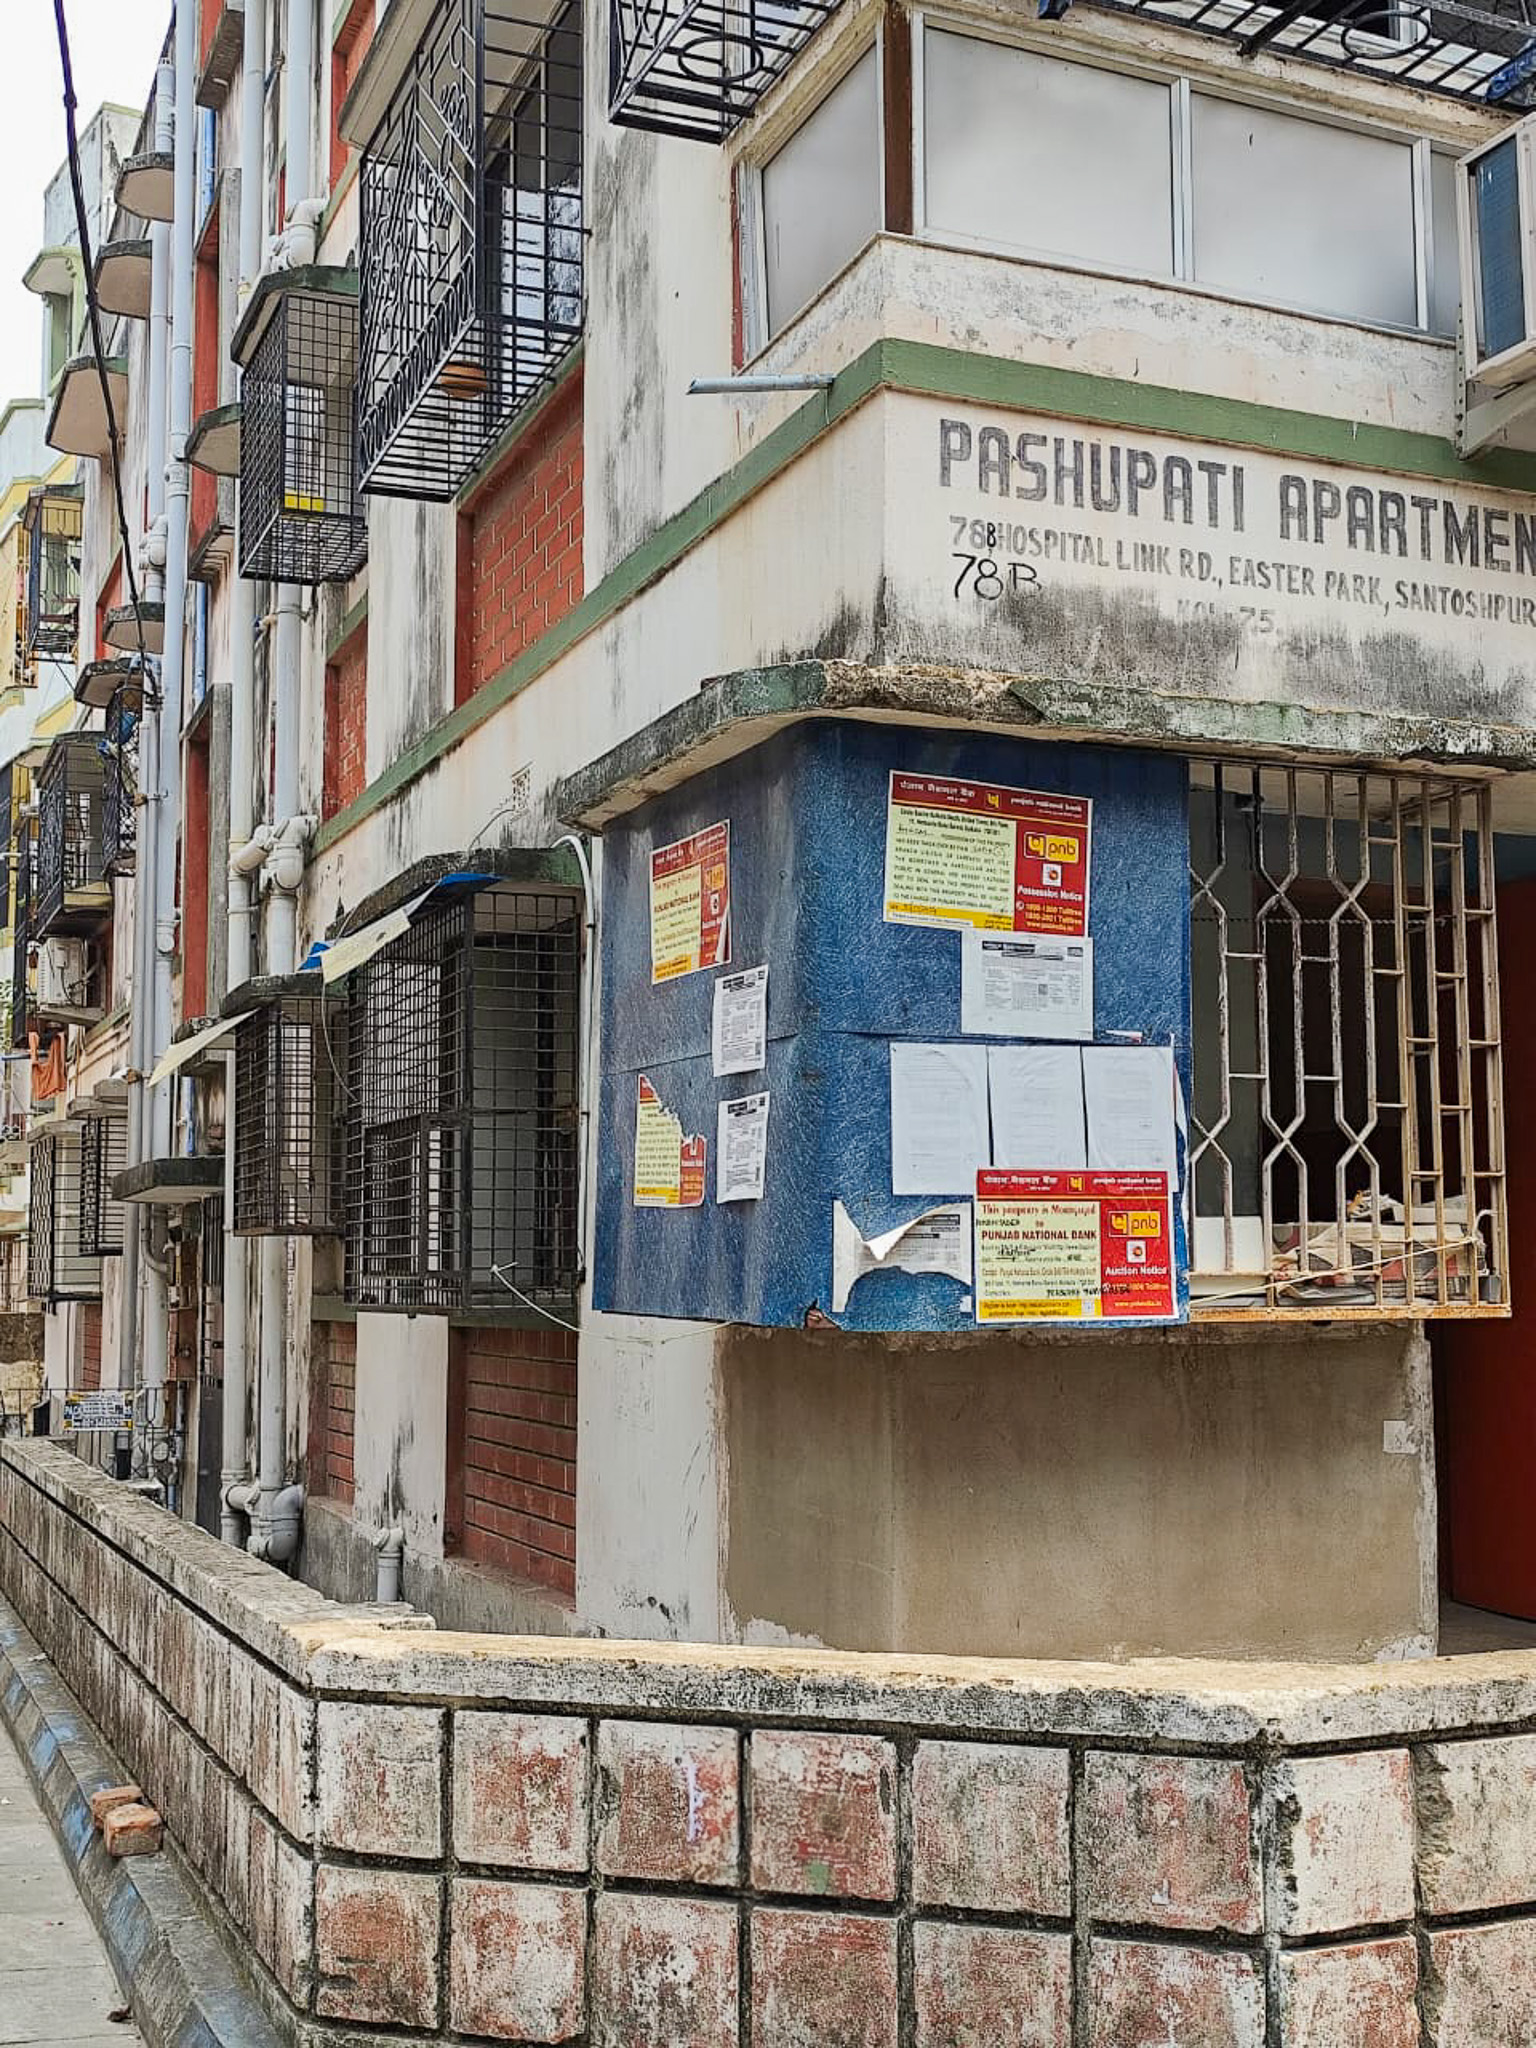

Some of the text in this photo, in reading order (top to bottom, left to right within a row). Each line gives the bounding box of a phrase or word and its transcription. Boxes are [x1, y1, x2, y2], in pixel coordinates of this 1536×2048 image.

[939, 418, 1536, 577] PASHUPATI APARTMEN
[997, 522, 1110, 567] HOSPITAL
[1116, 539, 1172, 576] LINK
[1229, 556, 1315, 597] EASTER
[1394, 580, 1536, 628] SANTOSHPUR
[1048, 840, 1076, 857] pnb
[982, 1204, 999, 1215] This
[1131, 1215, 1158, 1233] pnb
[982, 1230, 1097, 1241] PUNJAB NATIONAL BANK
[1105, 1266, 1139, 1276] Auction
